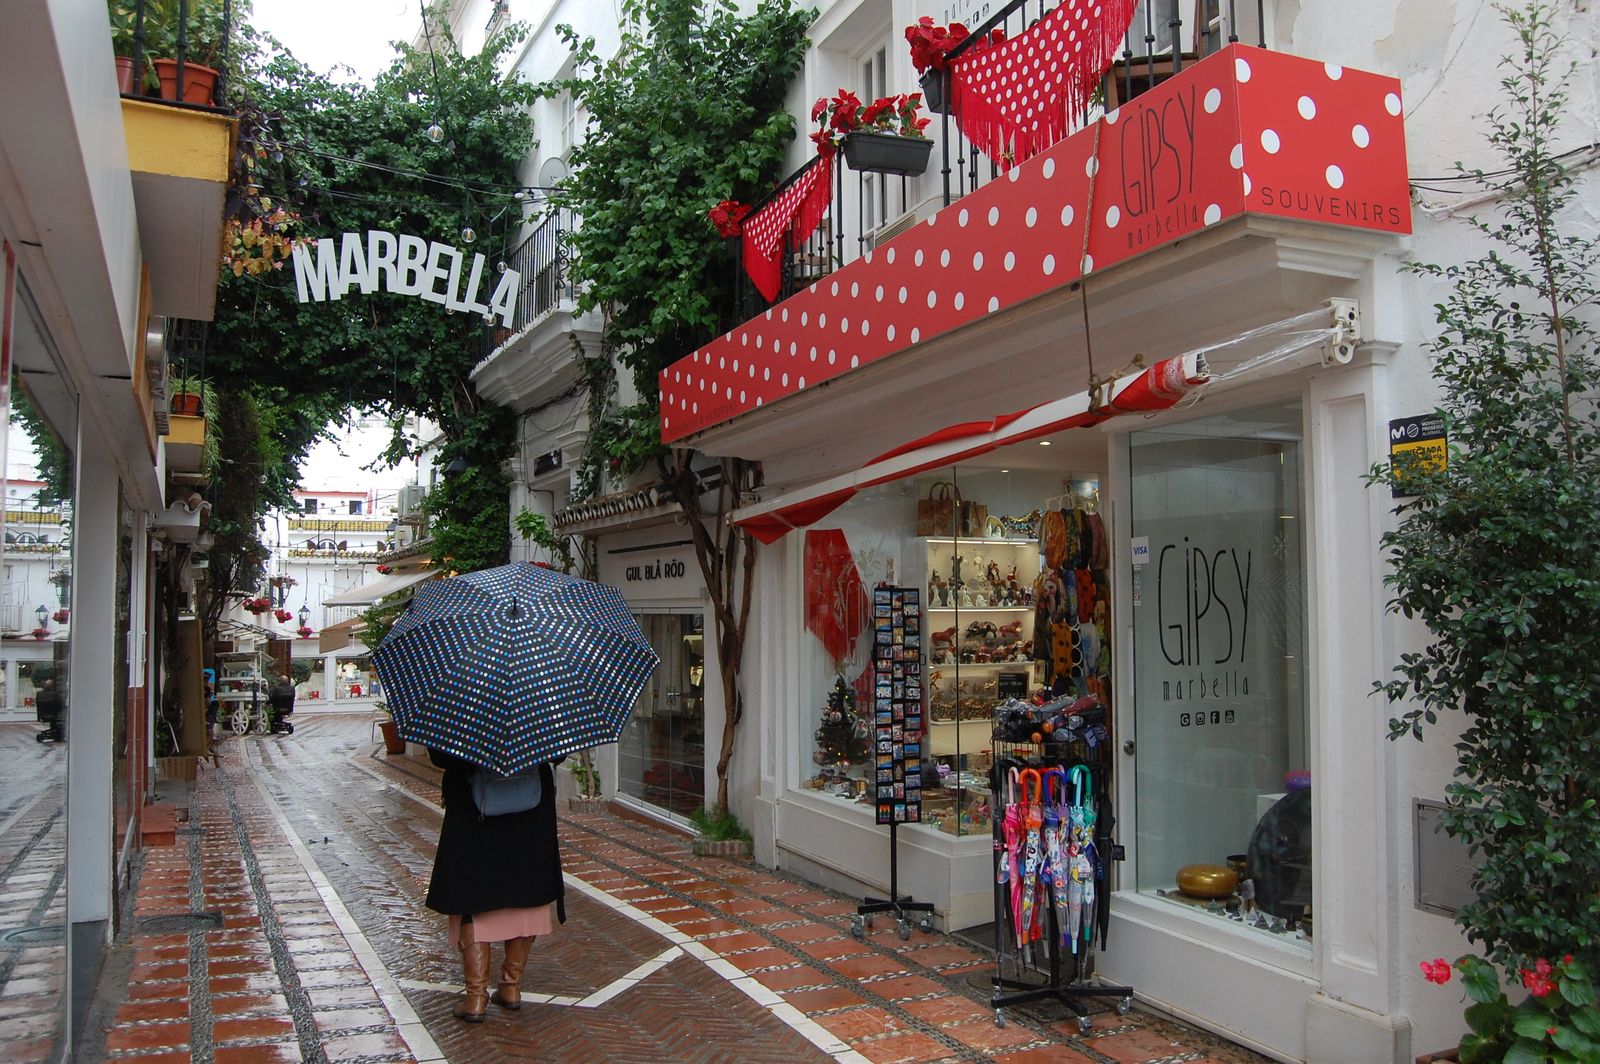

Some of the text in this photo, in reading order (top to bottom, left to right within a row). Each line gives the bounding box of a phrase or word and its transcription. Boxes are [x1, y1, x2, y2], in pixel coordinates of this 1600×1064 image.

[1261, 187, 1400, 226] SOUVENIRS
[292, 229, 521, 329] MARBELLA
[1133, 545, 1148, 555] VISA
[626, 559, 685, 581] GUL BLÅ RÖD
[1163, 671, 1249, 701] marbella
